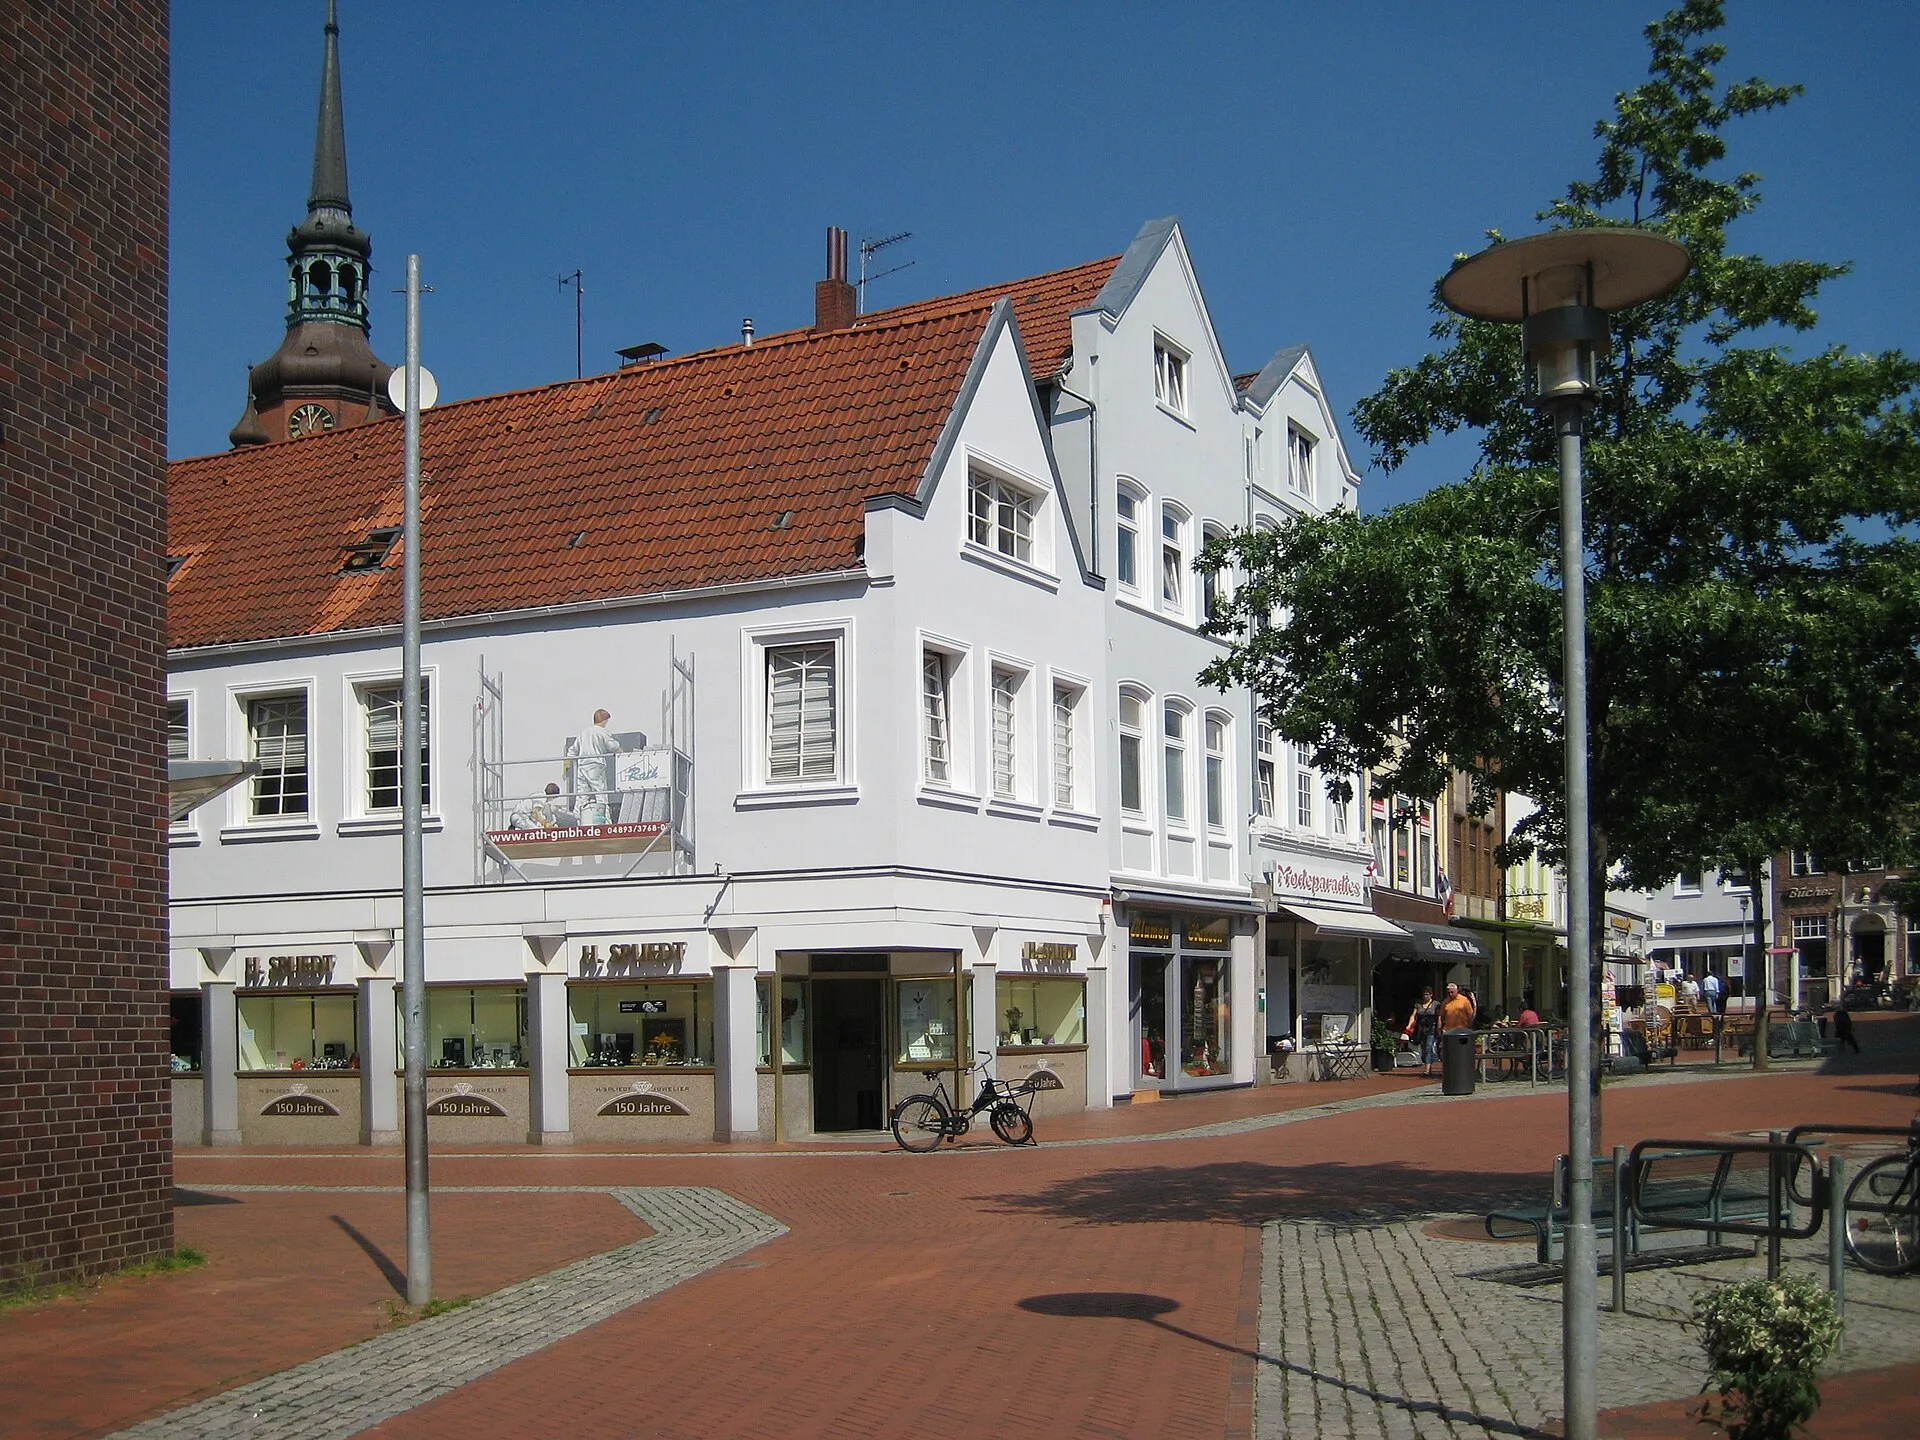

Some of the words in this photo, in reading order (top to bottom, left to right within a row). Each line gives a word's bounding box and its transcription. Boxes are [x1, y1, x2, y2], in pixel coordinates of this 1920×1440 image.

[490, 826, 601, 842] www.rath-gmbh.de
[1277, 864, 1361, 897] Modeparadies
[608, 942, 688, 962] SPLIEDT
[1040, 1077, 1057, 1088] Jahre
[275, 1103, 293, 1113] 150
[295, 1103, 325, 1113] Jahre
[438, 1103, 457, 1113] 150
[459, 1102, 491, 1114] Jahre
[614, 1102, 635, 1113] 150
[637, 1101, 672, 1113] Jahre
